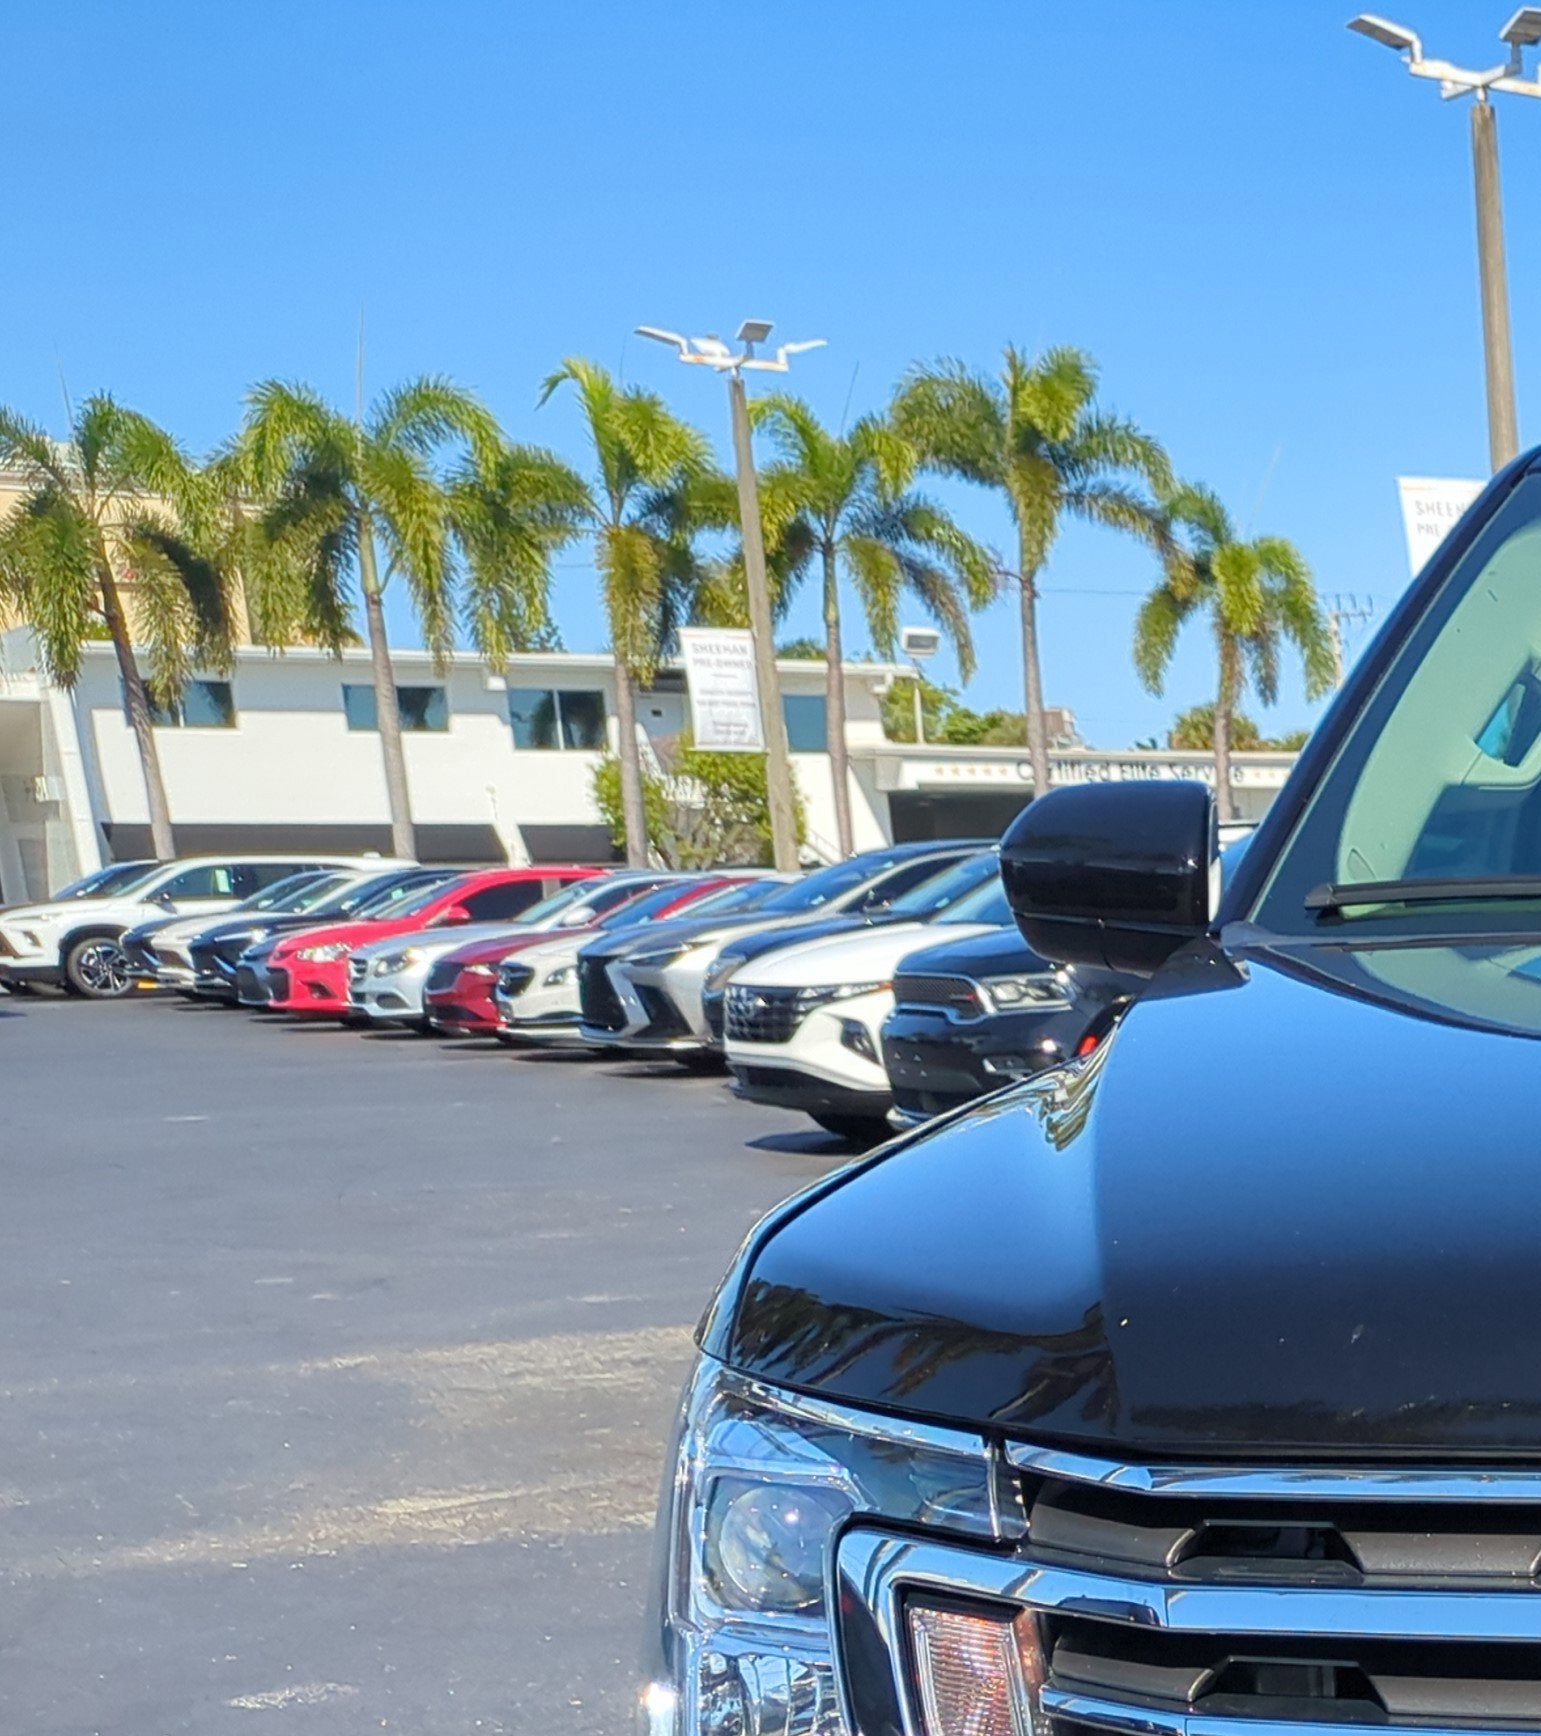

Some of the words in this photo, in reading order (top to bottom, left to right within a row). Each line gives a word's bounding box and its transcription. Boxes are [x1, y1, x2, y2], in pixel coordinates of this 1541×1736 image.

[1415, 499, 1467, 518] SHEEH
[692, 642, 748, 656] SHEEHAN
[1017, 760, 1110, 782] Crtified
[1168, 760, 1244, 782] Serve
